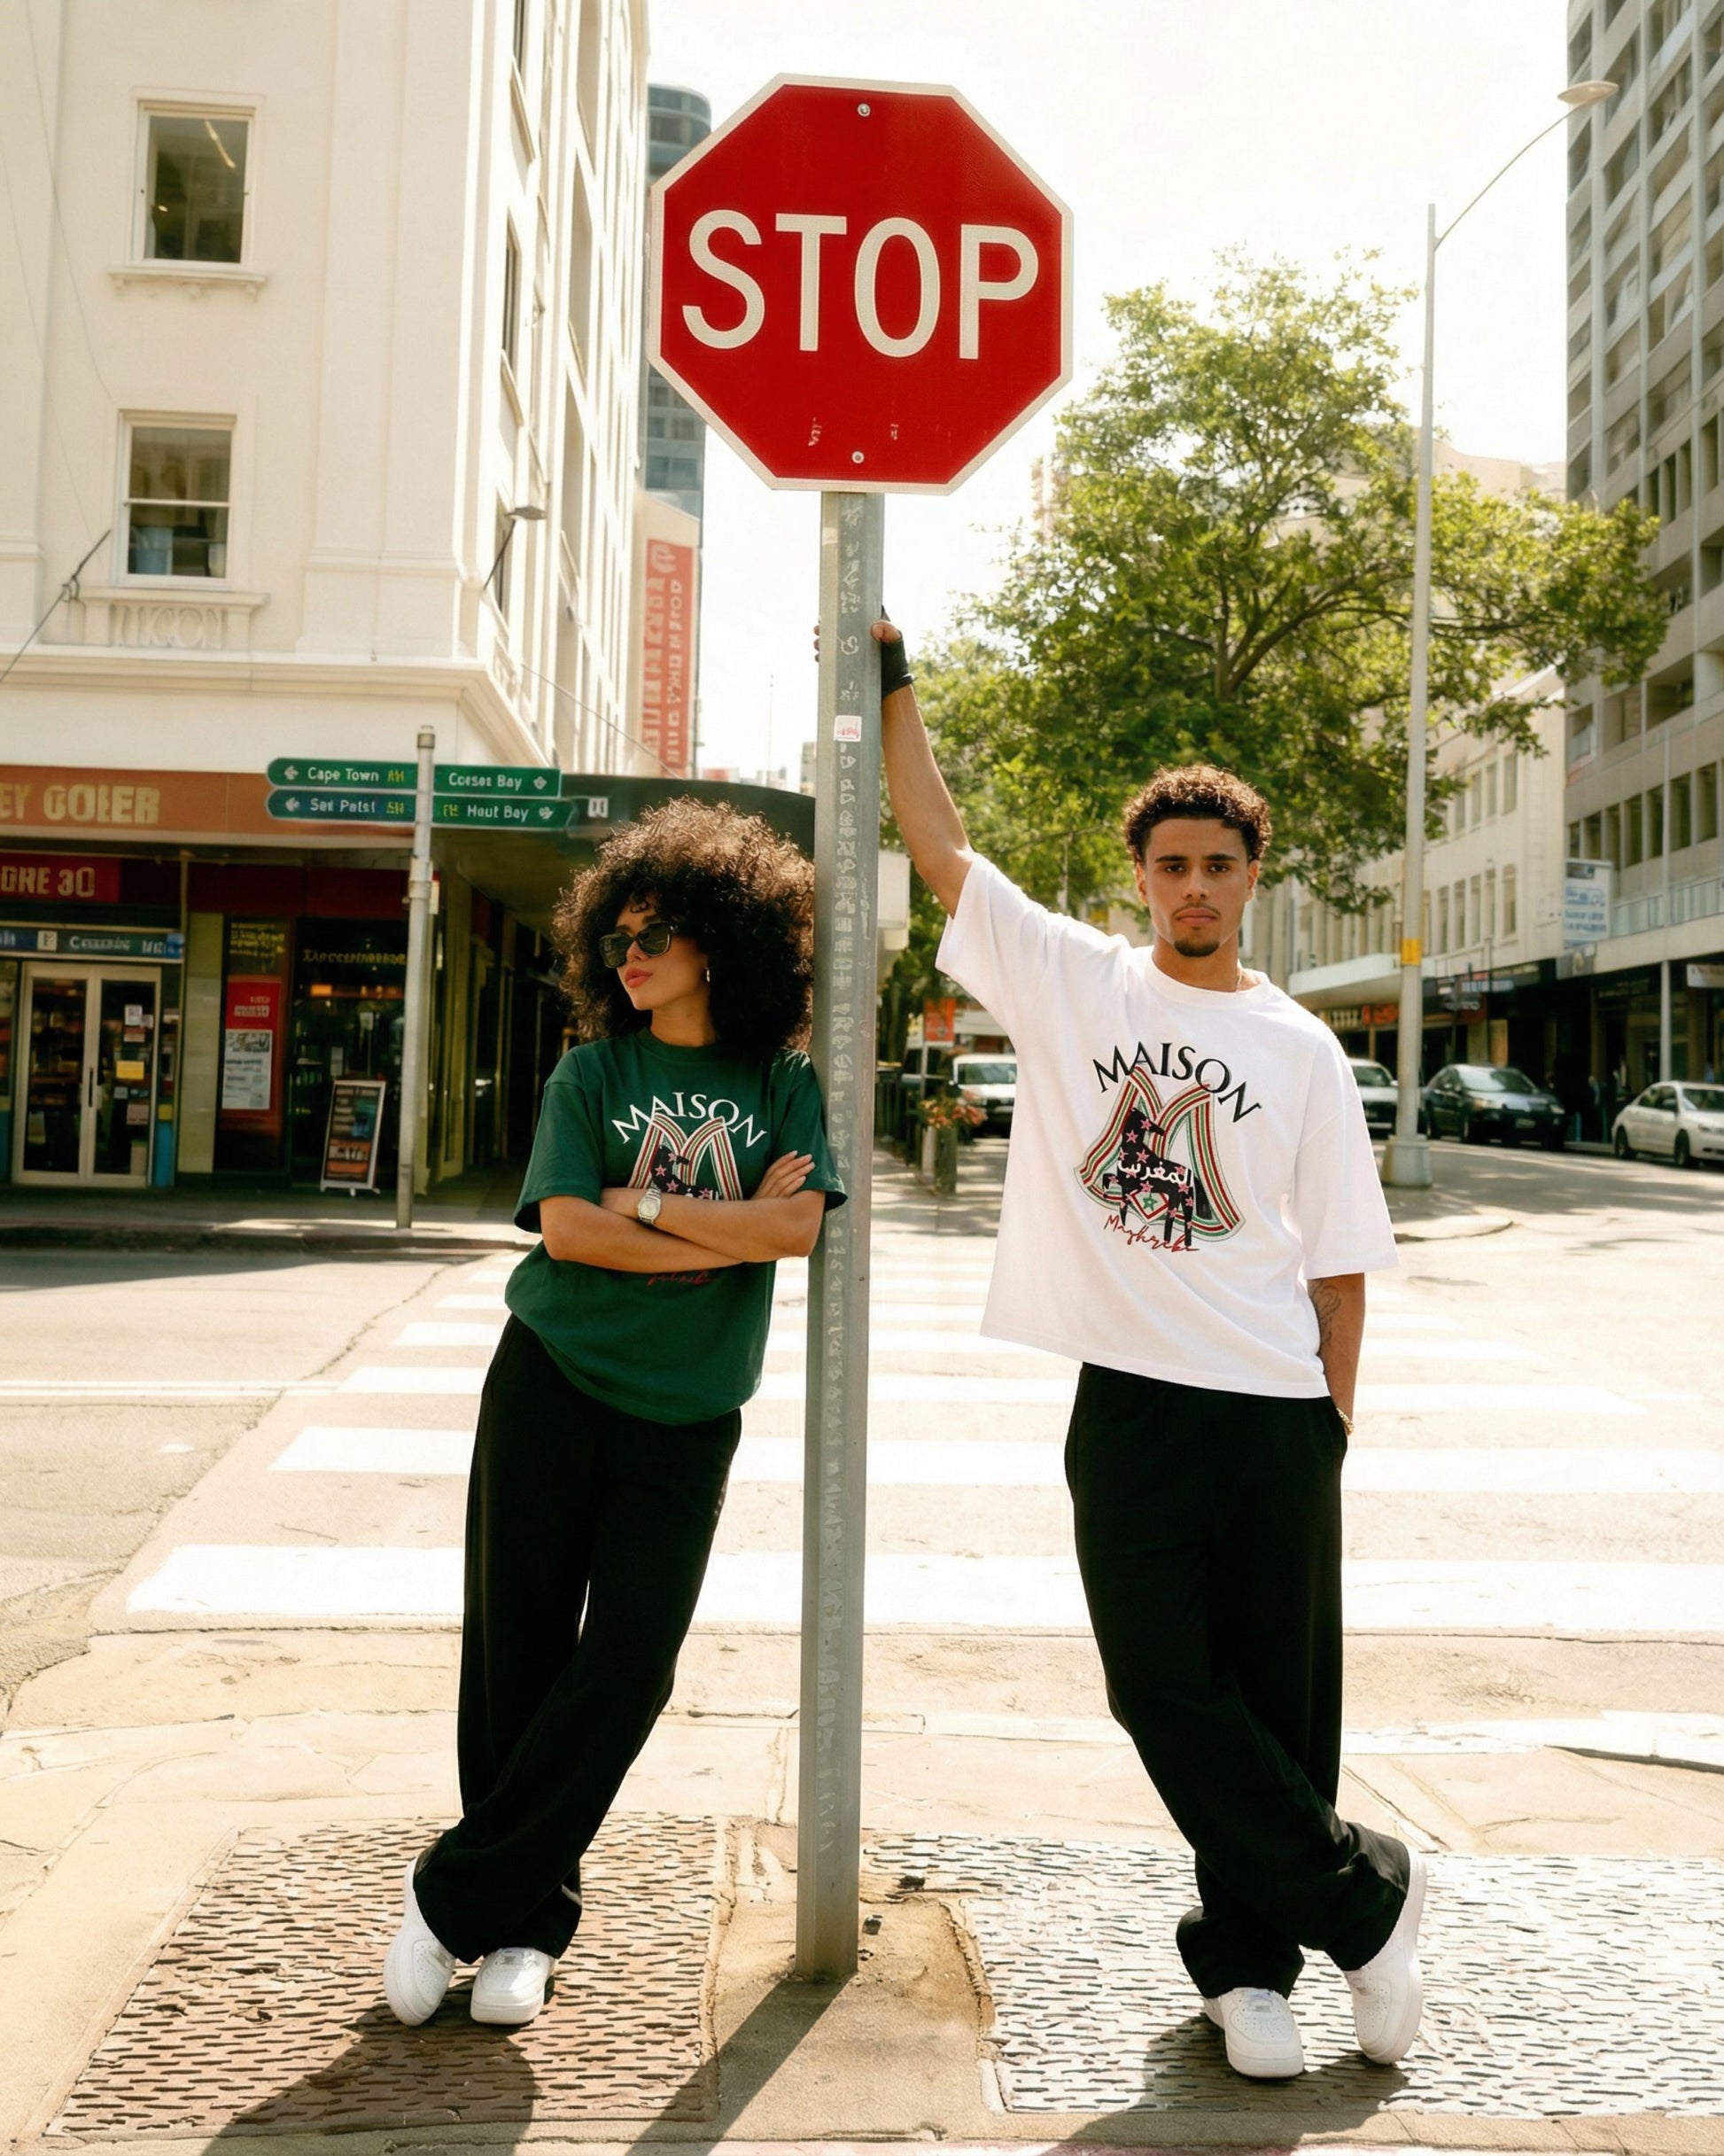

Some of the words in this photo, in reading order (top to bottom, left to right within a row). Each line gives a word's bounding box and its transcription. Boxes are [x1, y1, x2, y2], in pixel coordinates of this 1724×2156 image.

[682, 209, 1039, 360] STOP
[307, 767, 340, 784] Cape
[346, 767, 379, 782] Town
[497, 774, 523, 791] Bay
[503, 806, 530, 823] Bay
[1092, 1040, 1262, 1124] MAISON
[611, 1091, 768, 1148] MAISON
